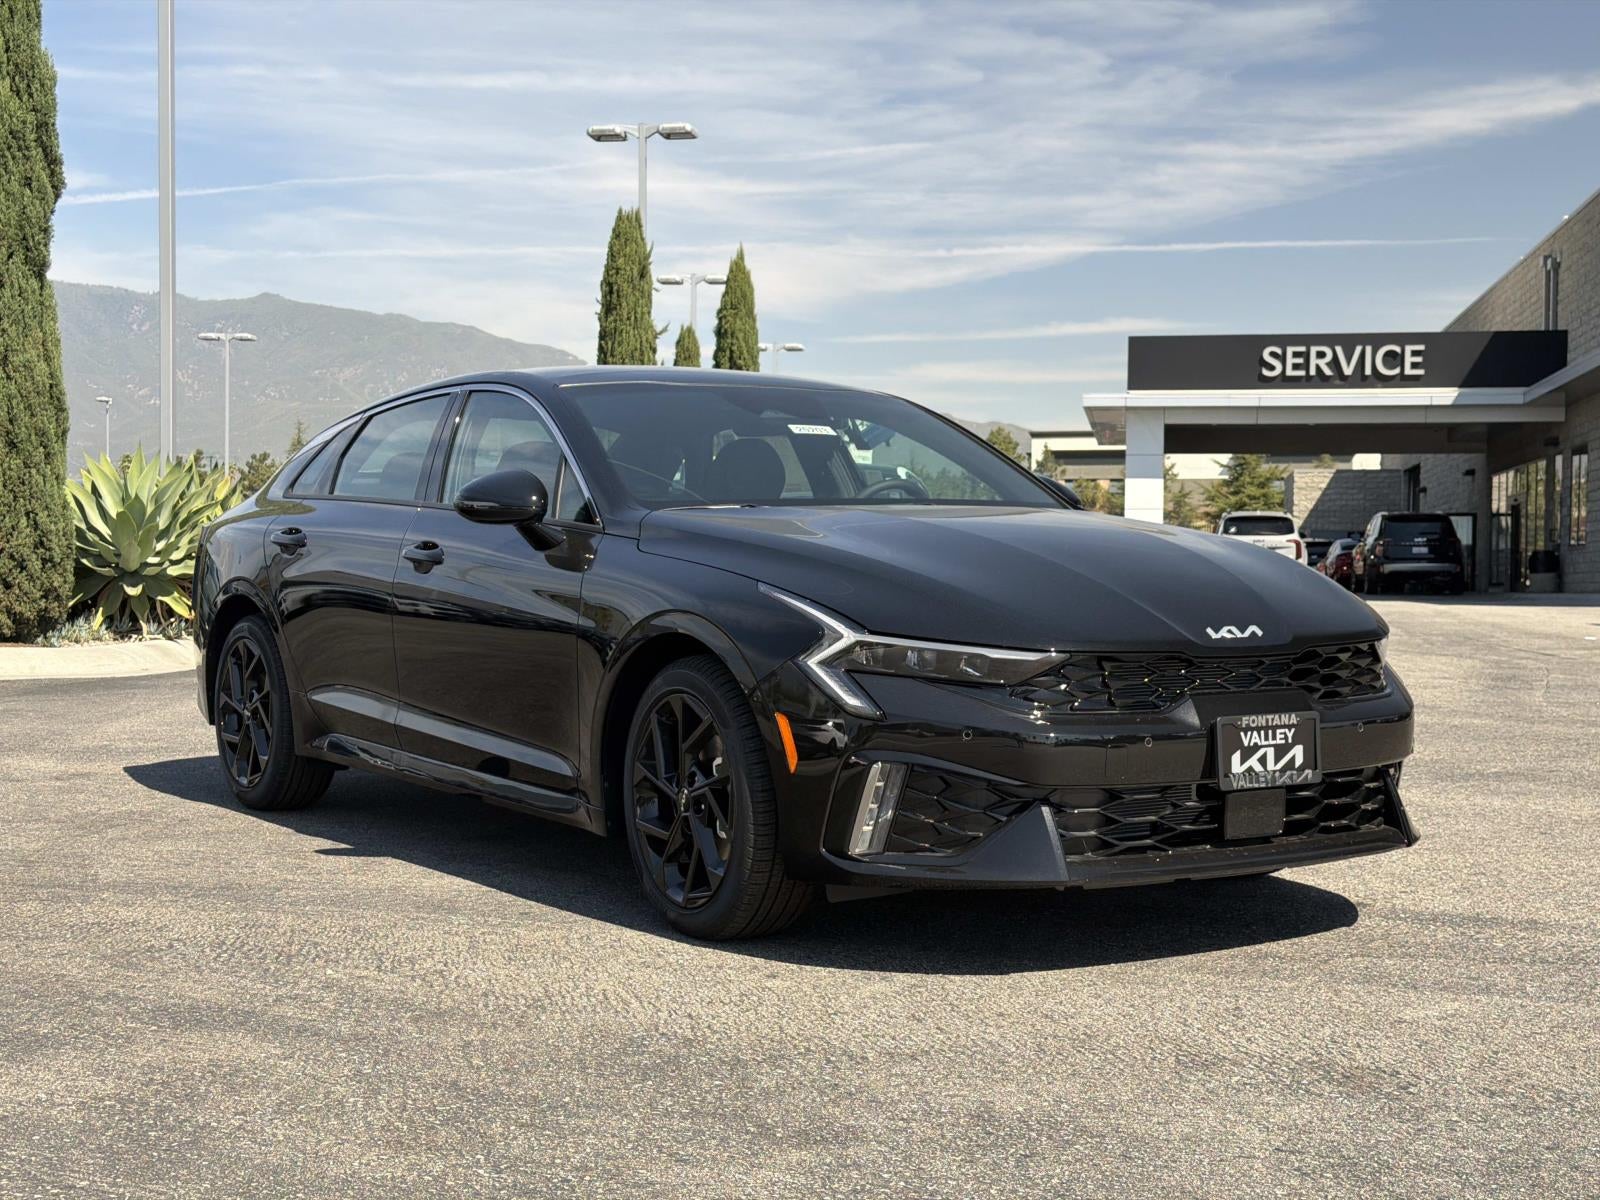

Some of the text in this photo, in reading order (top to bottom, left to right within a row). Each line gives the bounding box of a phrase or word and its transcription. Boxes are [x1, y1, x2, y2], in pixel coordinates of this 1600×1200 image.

[1261, 344, 1426, 377] SERVICE
[1206, 625, 1263, 639] KIA
[1241, 713, 1298, 728] FONTANA
[1240, 728, 1296, 747] VALLEY
[1231, 744, 1304, 774] KIA
[1228, 768, 1313, 790] VALLEY KIA
